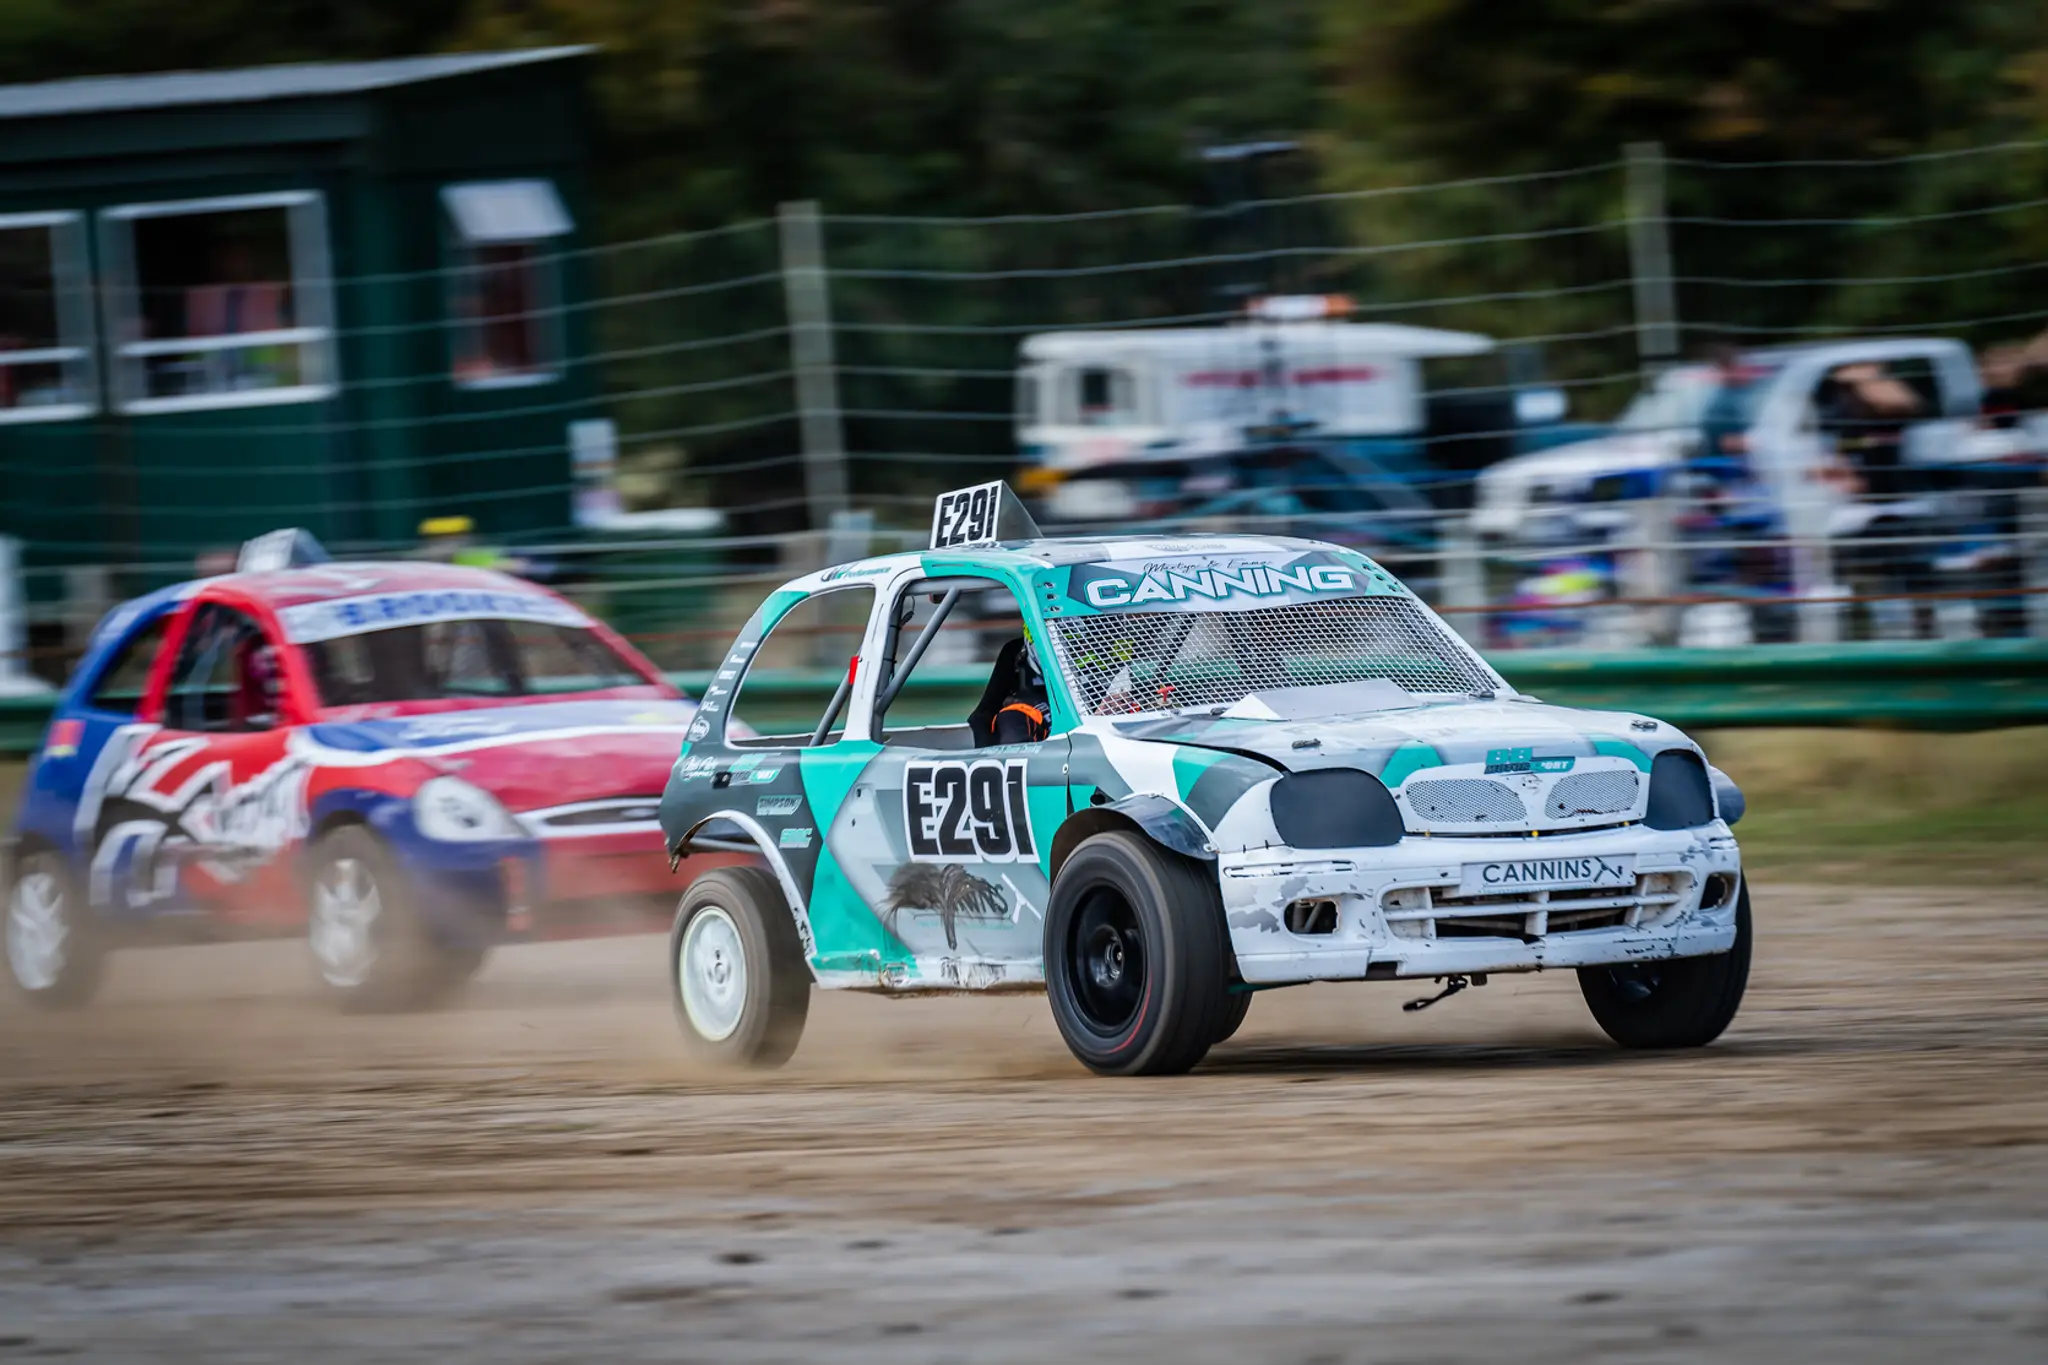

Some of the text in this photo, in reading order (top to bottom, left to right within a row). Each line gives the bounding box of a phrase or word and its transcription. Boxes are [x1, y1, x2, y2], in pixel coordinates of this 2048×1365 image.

[935, 486, 999, 548] E291
[1084, 564, 1357, 607] CANNING
[906, 765, 1036, 857] E291
